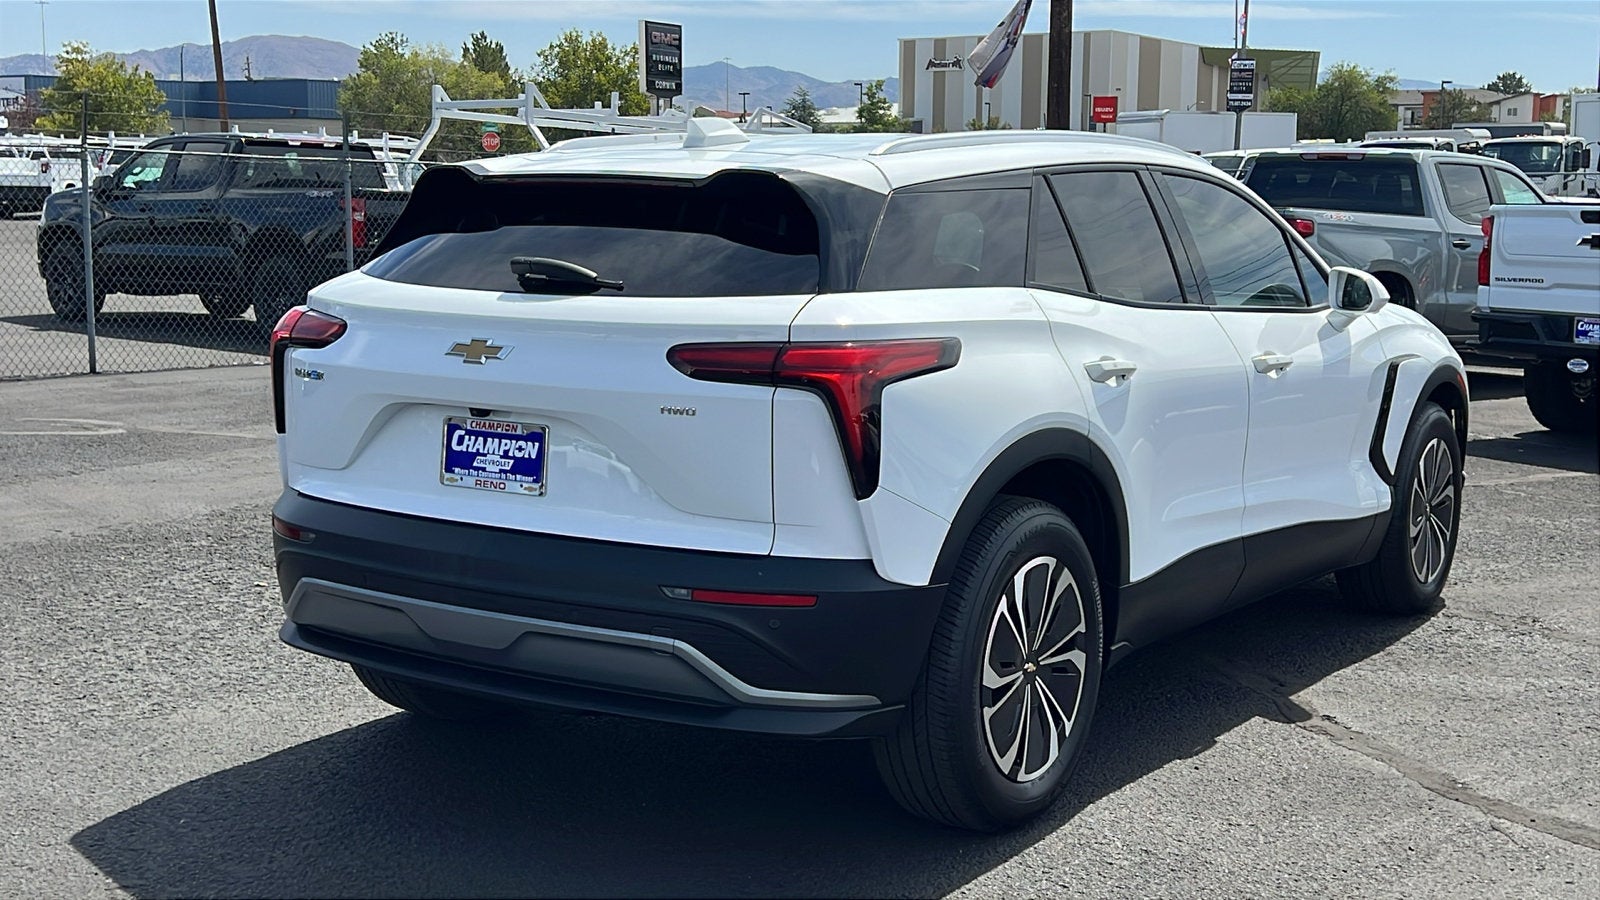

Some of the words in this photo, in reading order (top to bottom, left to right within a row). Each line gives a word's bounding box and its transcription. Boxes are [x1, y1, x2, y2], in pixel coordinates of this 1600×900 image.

[652, 31, 680, 46] GMC
[652, 53, 679, 63] BUSINESS
[658, 64, 674, 72] ELITE
[484, 138, 499, 146] STOP
[1494, 276, 1545, 284] SILVERADO
[660, 405, 697, 417] AWD
[470, 420, 519, 433] CHAMPION
[451, 429, 540, 459] CHAMPION
[476, 458, 511, 468] CHEVROLET
[469, 468, 478, 477] The
[507, 473, 515, 481] The
[474, 479, 507, 491] RENO
